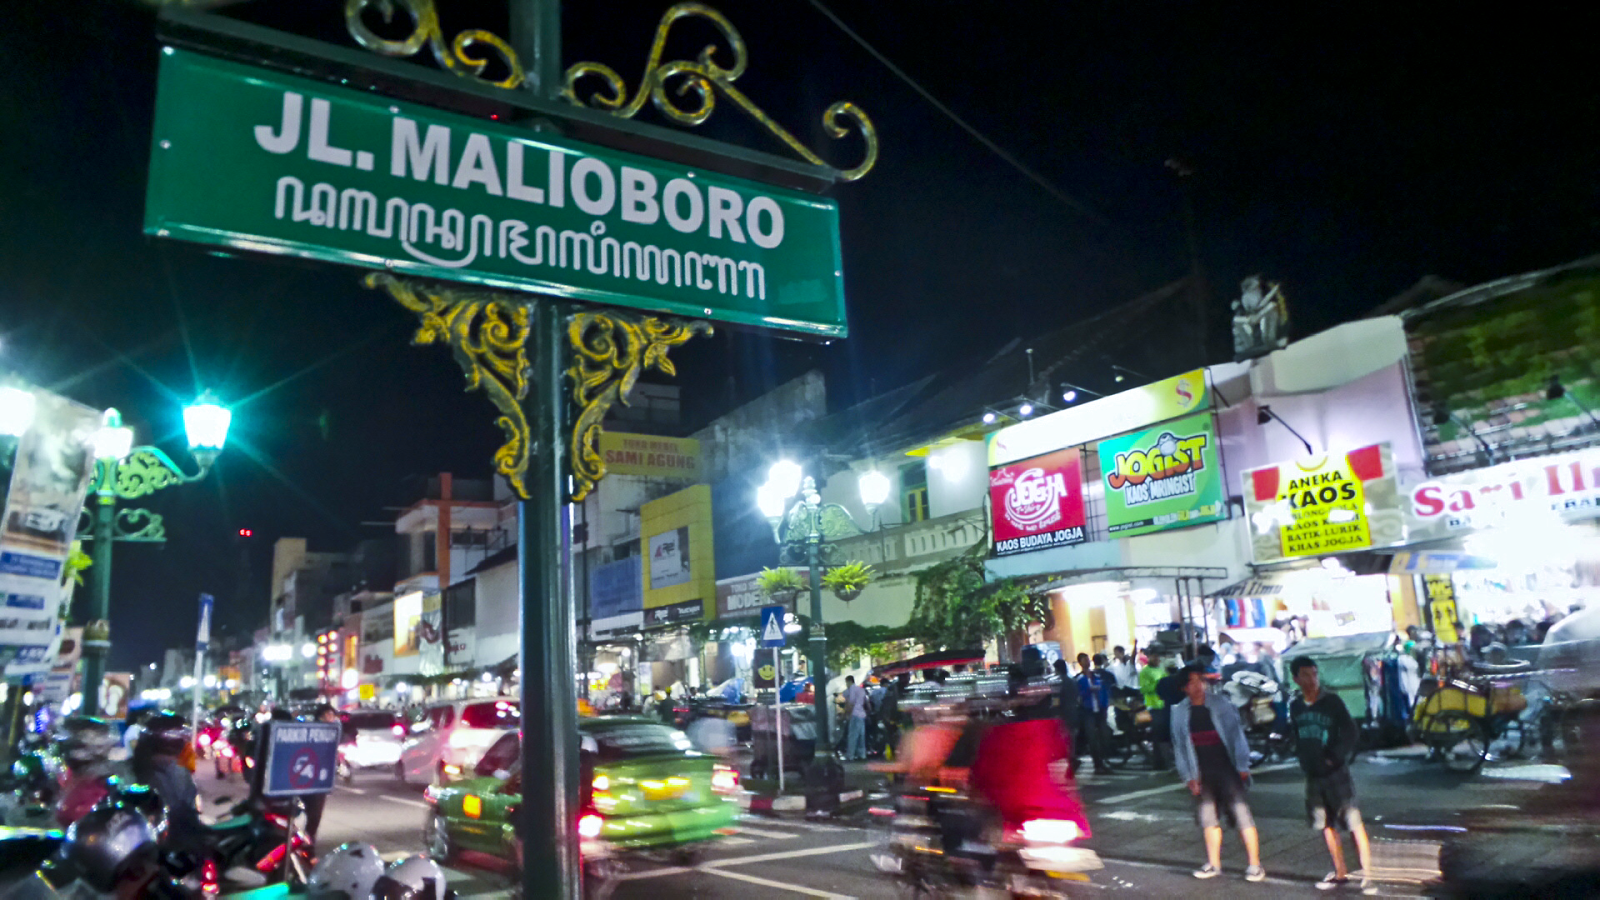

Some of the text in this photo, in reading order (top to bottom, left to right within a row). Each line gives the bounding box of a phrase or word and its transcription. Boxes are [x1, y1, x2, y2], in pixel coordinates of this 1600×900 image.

[253, 92, 785, 250] JL. MALIOBORO
[606, 450, 695, 469] SAMI AGUNG
[1107, 434, 1207, 489] JOGIST
[1125, 474, 1195, 505] KAOS MRINGIST
[1289, 470, 1343, 490] ANEKA
[1291, 508, 1326, 520] BLONG
[1286, 520, 1319, 531] KAOS
[1288, 525, 1361, 542] BATIK LURIK
[996, 538, 1018, 552] KAOS
[1020, 533, 1052, 548] BUDAYA
[1054, 527, 1083, 542] JOGJA
[1289, 535, 1363, 552] KHAS JOGJA
[727, 591, 776, 611] MODE
